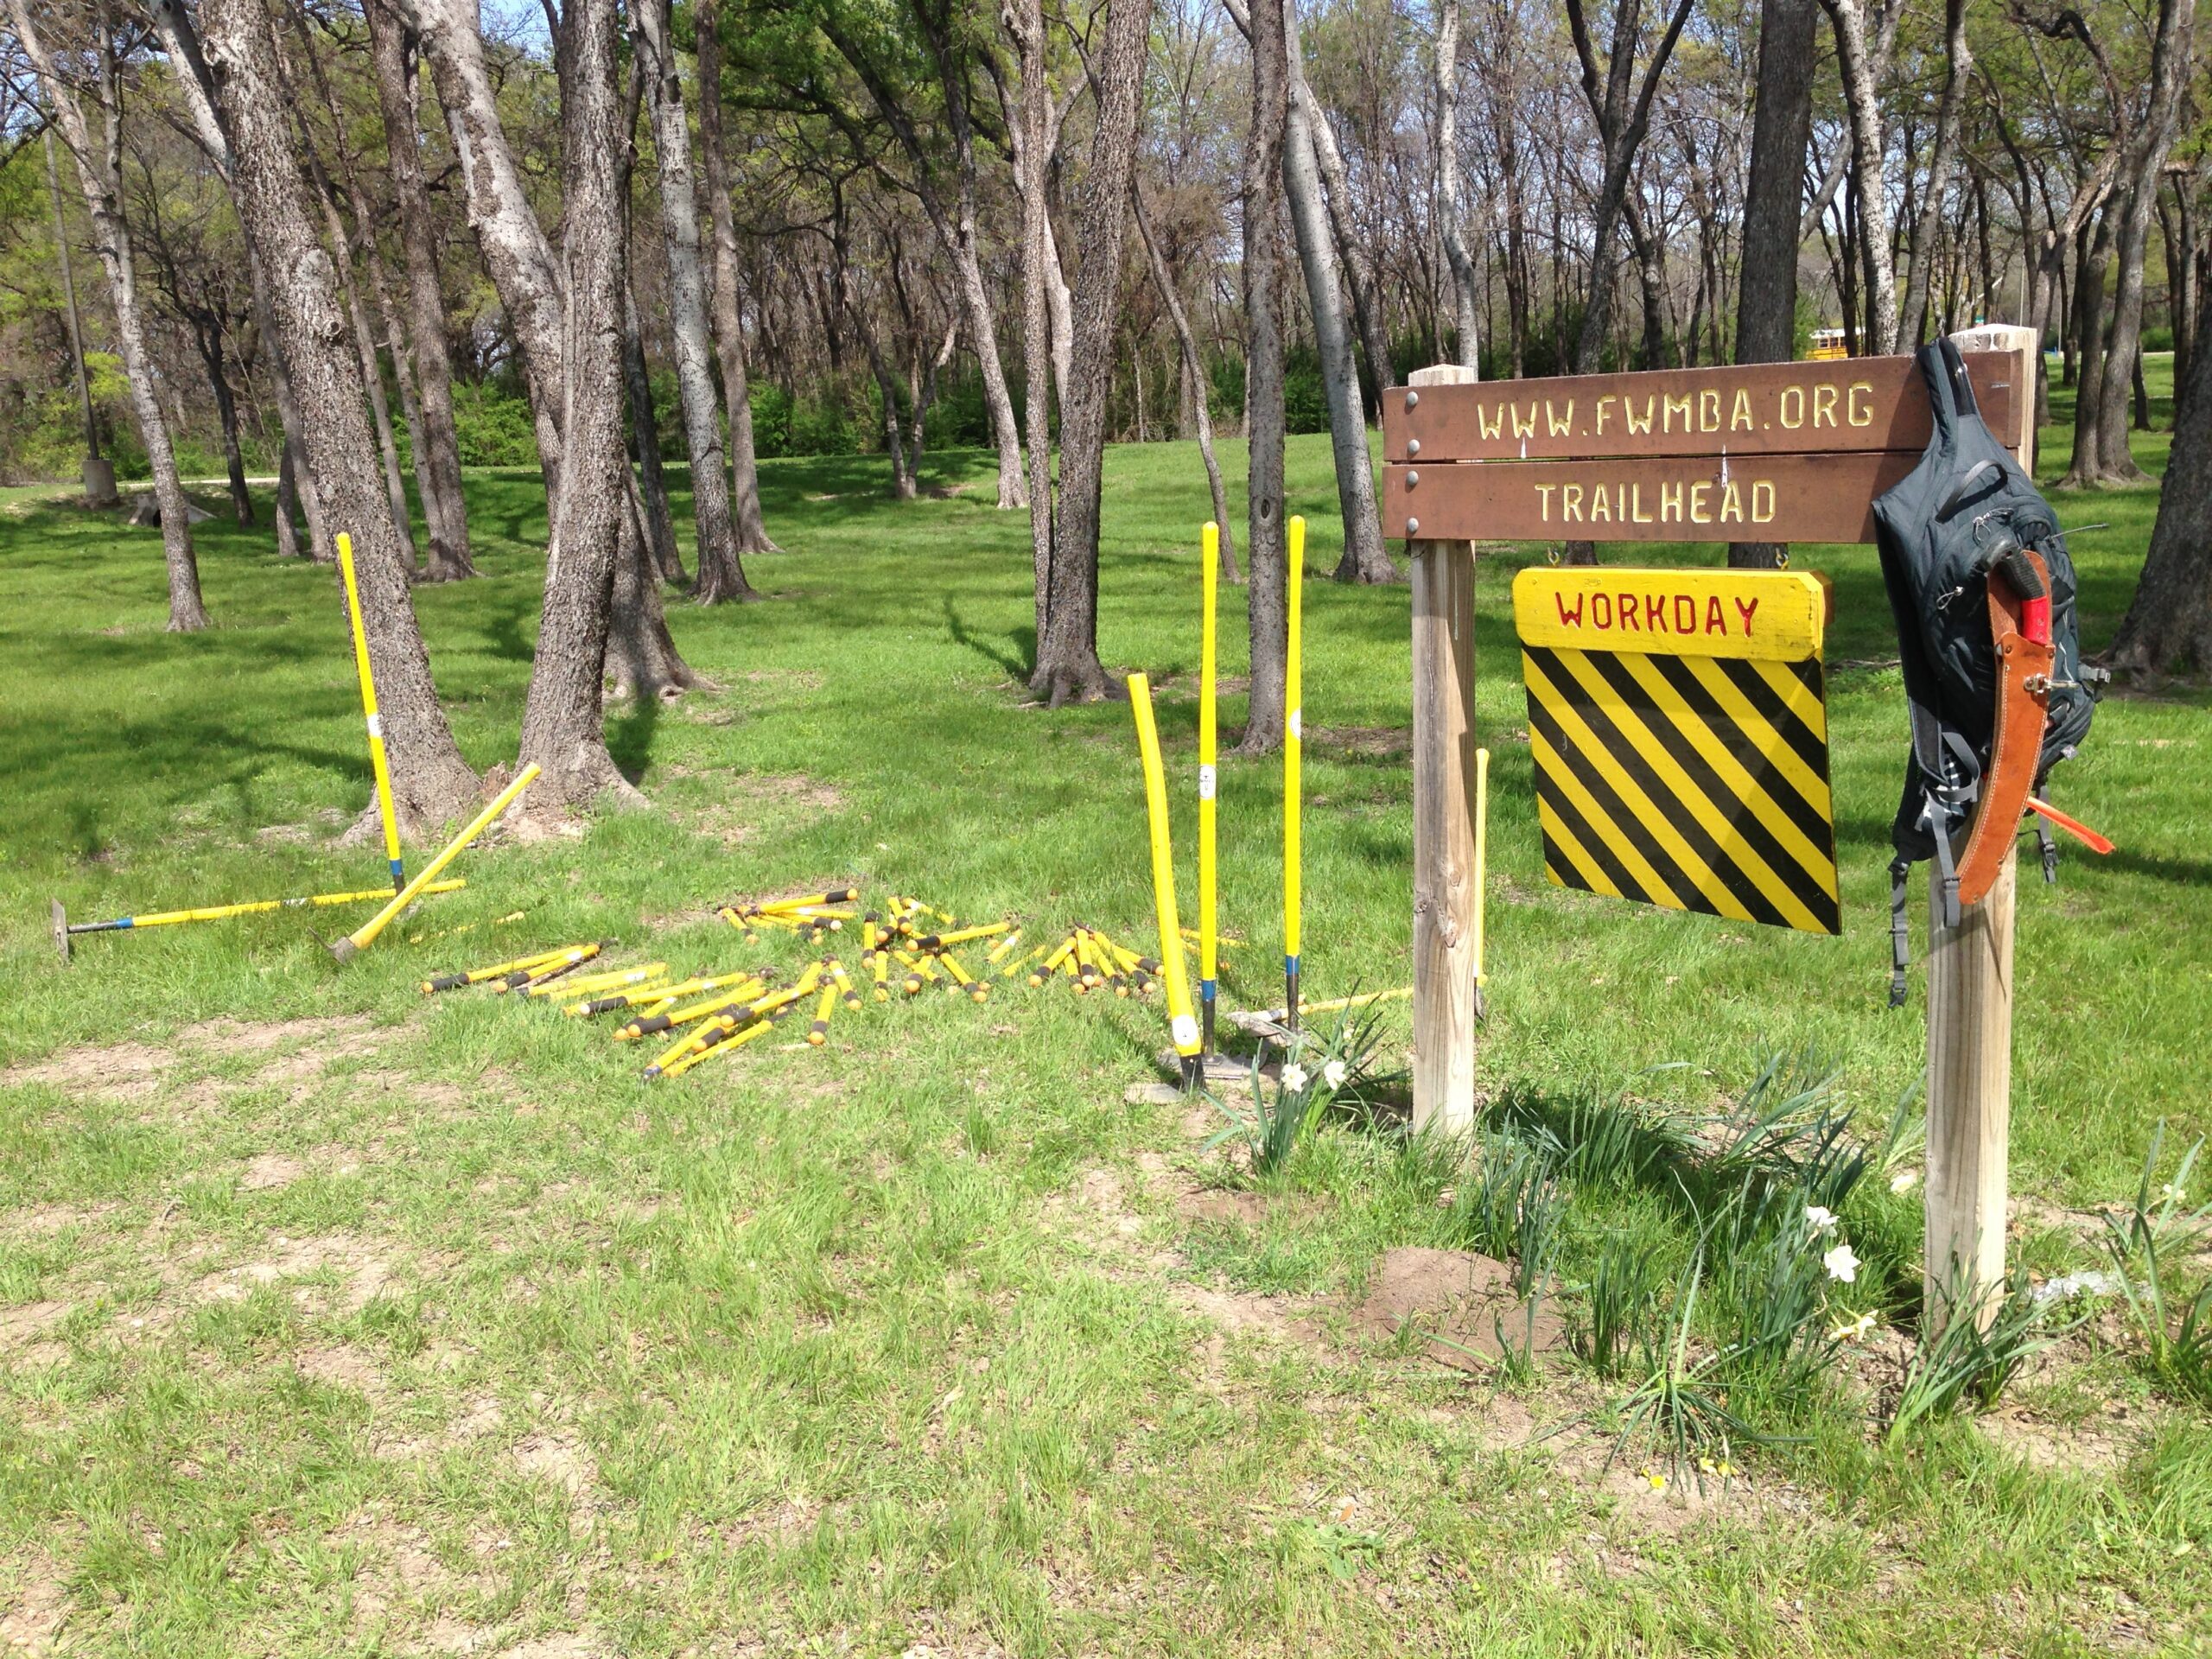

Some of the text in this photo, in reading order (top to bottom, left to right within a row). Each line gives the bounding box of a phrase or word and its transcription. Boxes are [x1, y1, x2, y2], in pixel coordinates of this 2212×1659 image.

[1478, 380, 1874, 440] WWW.FWMBA.ORG
[1535, 480, 1776, 523] TRAILHEAD
[1555, 592, 1758, 638] WORKDAY
